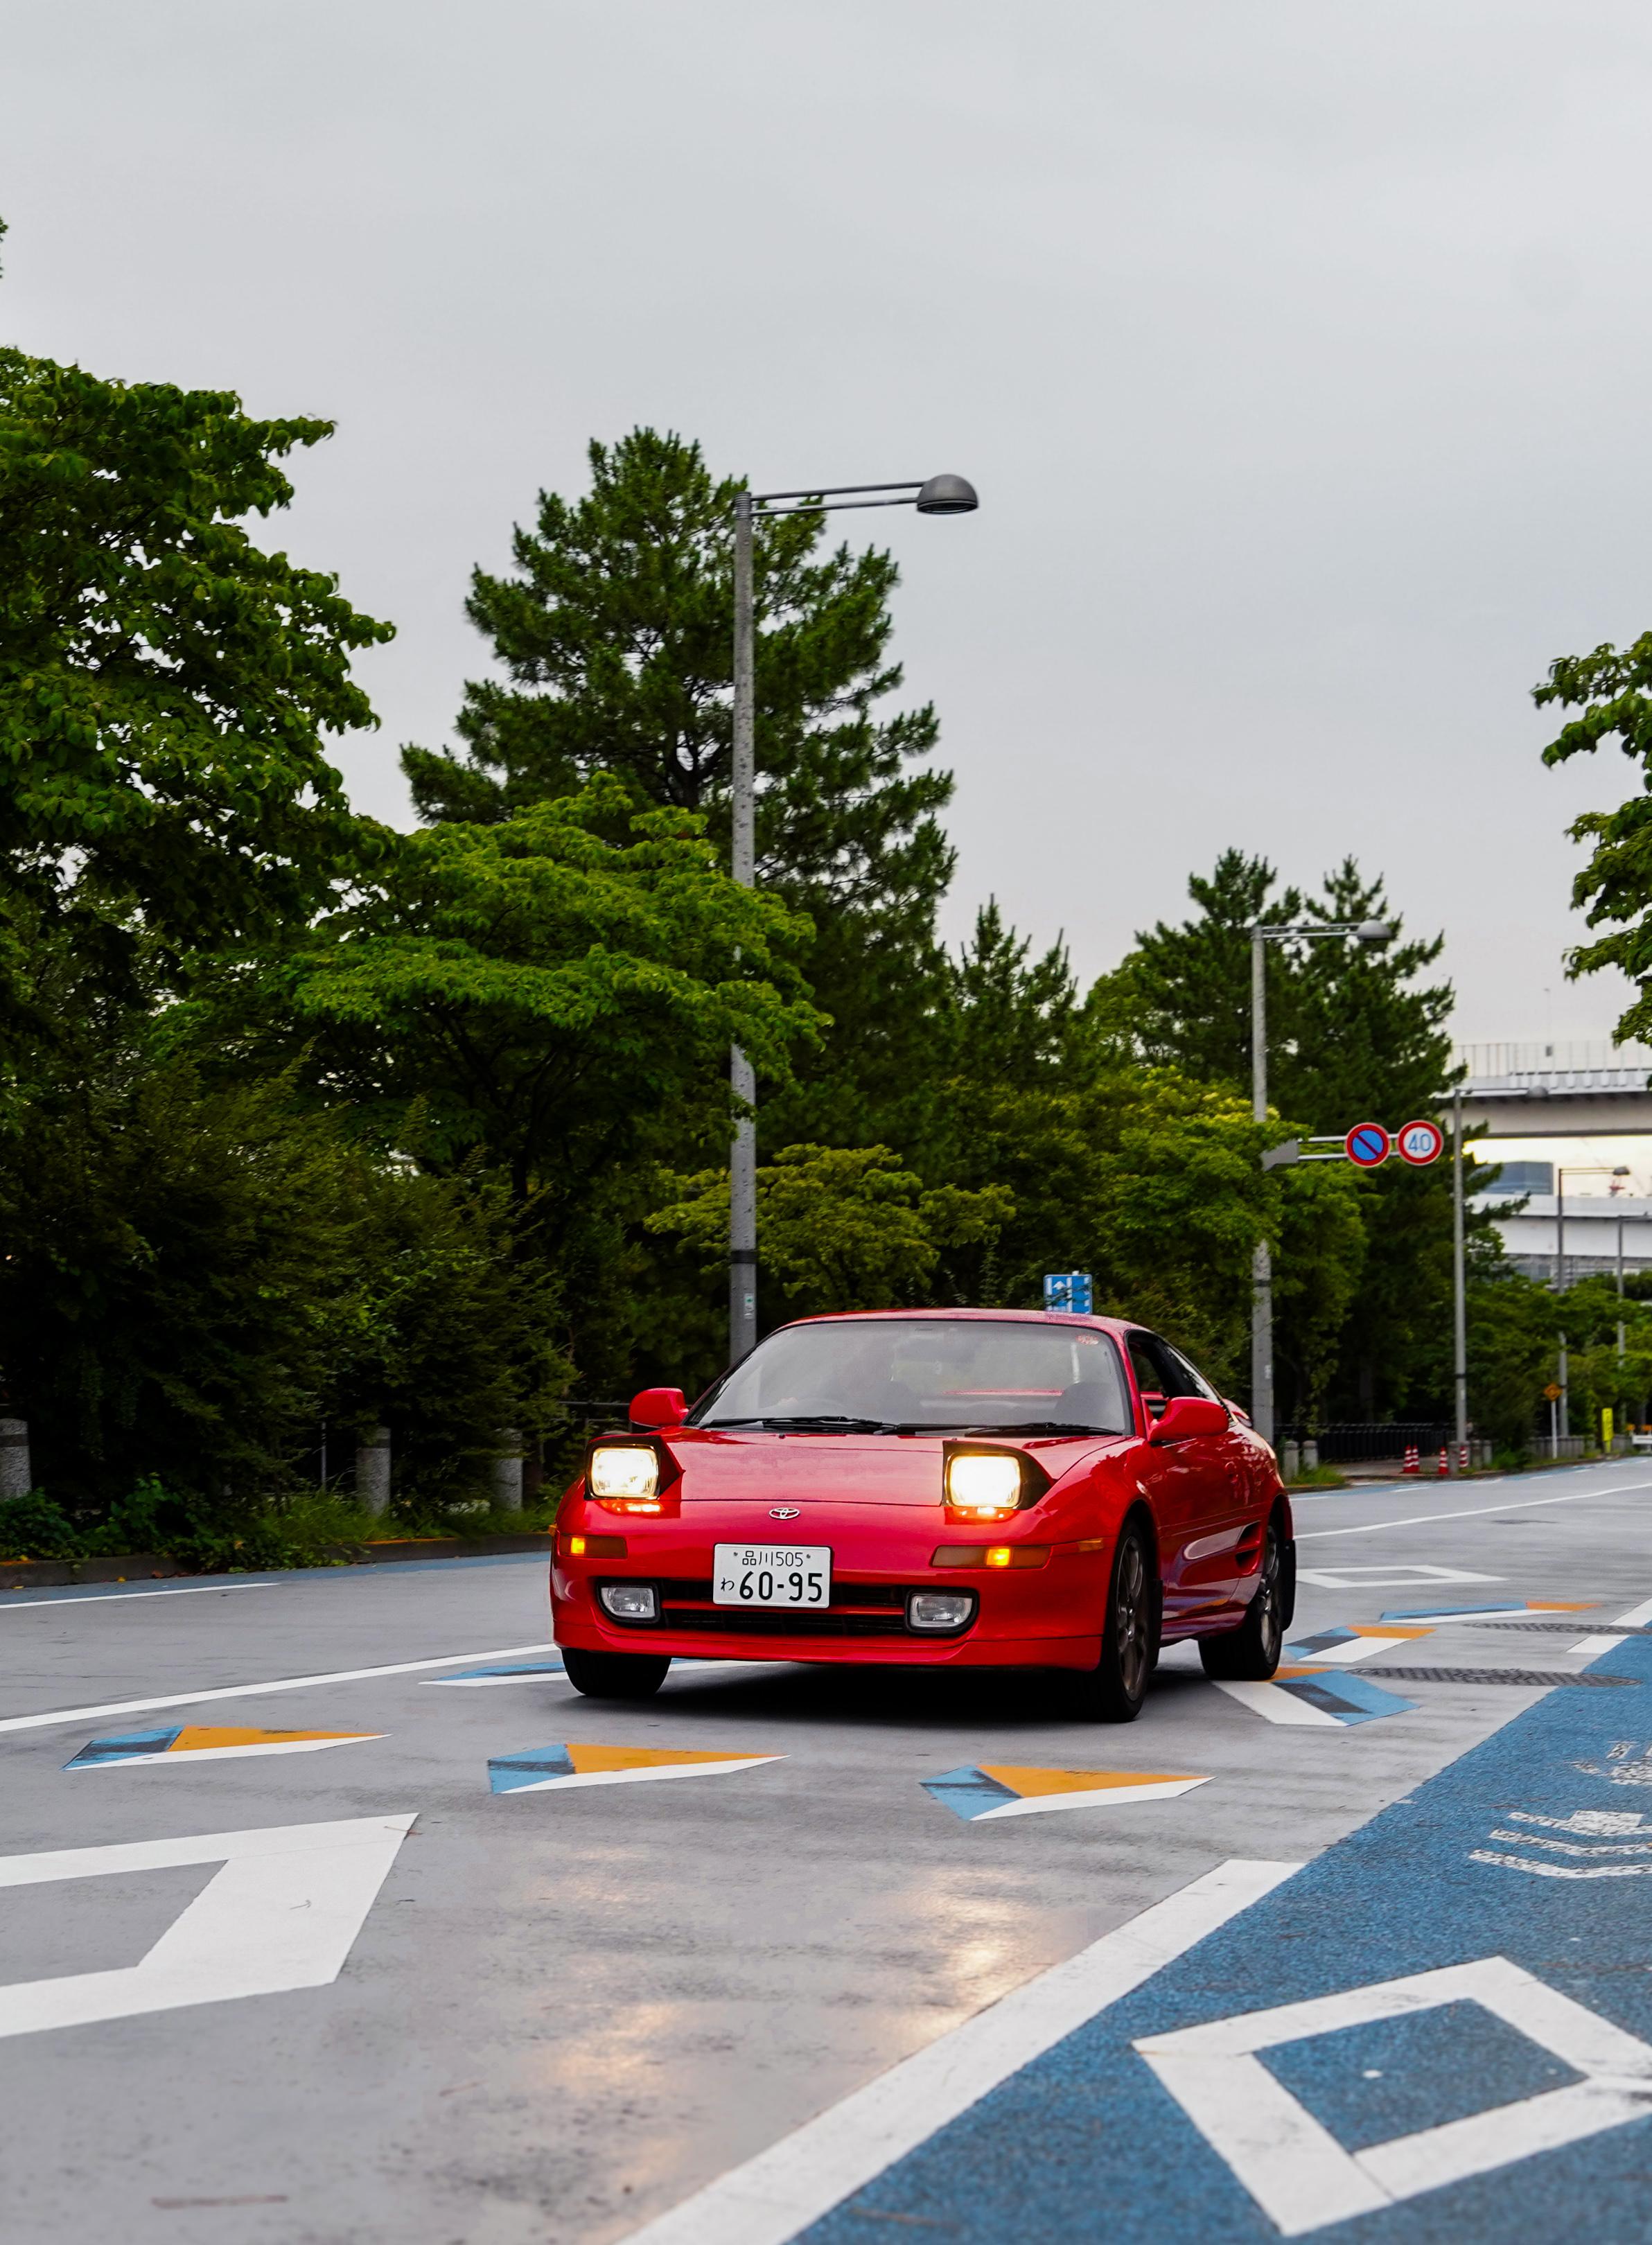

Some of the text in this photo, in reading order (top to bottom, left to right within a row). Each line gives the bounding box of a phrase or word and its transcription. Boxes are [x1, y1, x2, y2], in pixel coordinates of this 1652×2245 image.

[1407, 1134, 1432, 1152] 40
[720, 1571, 823, 1602] わ 60-95
